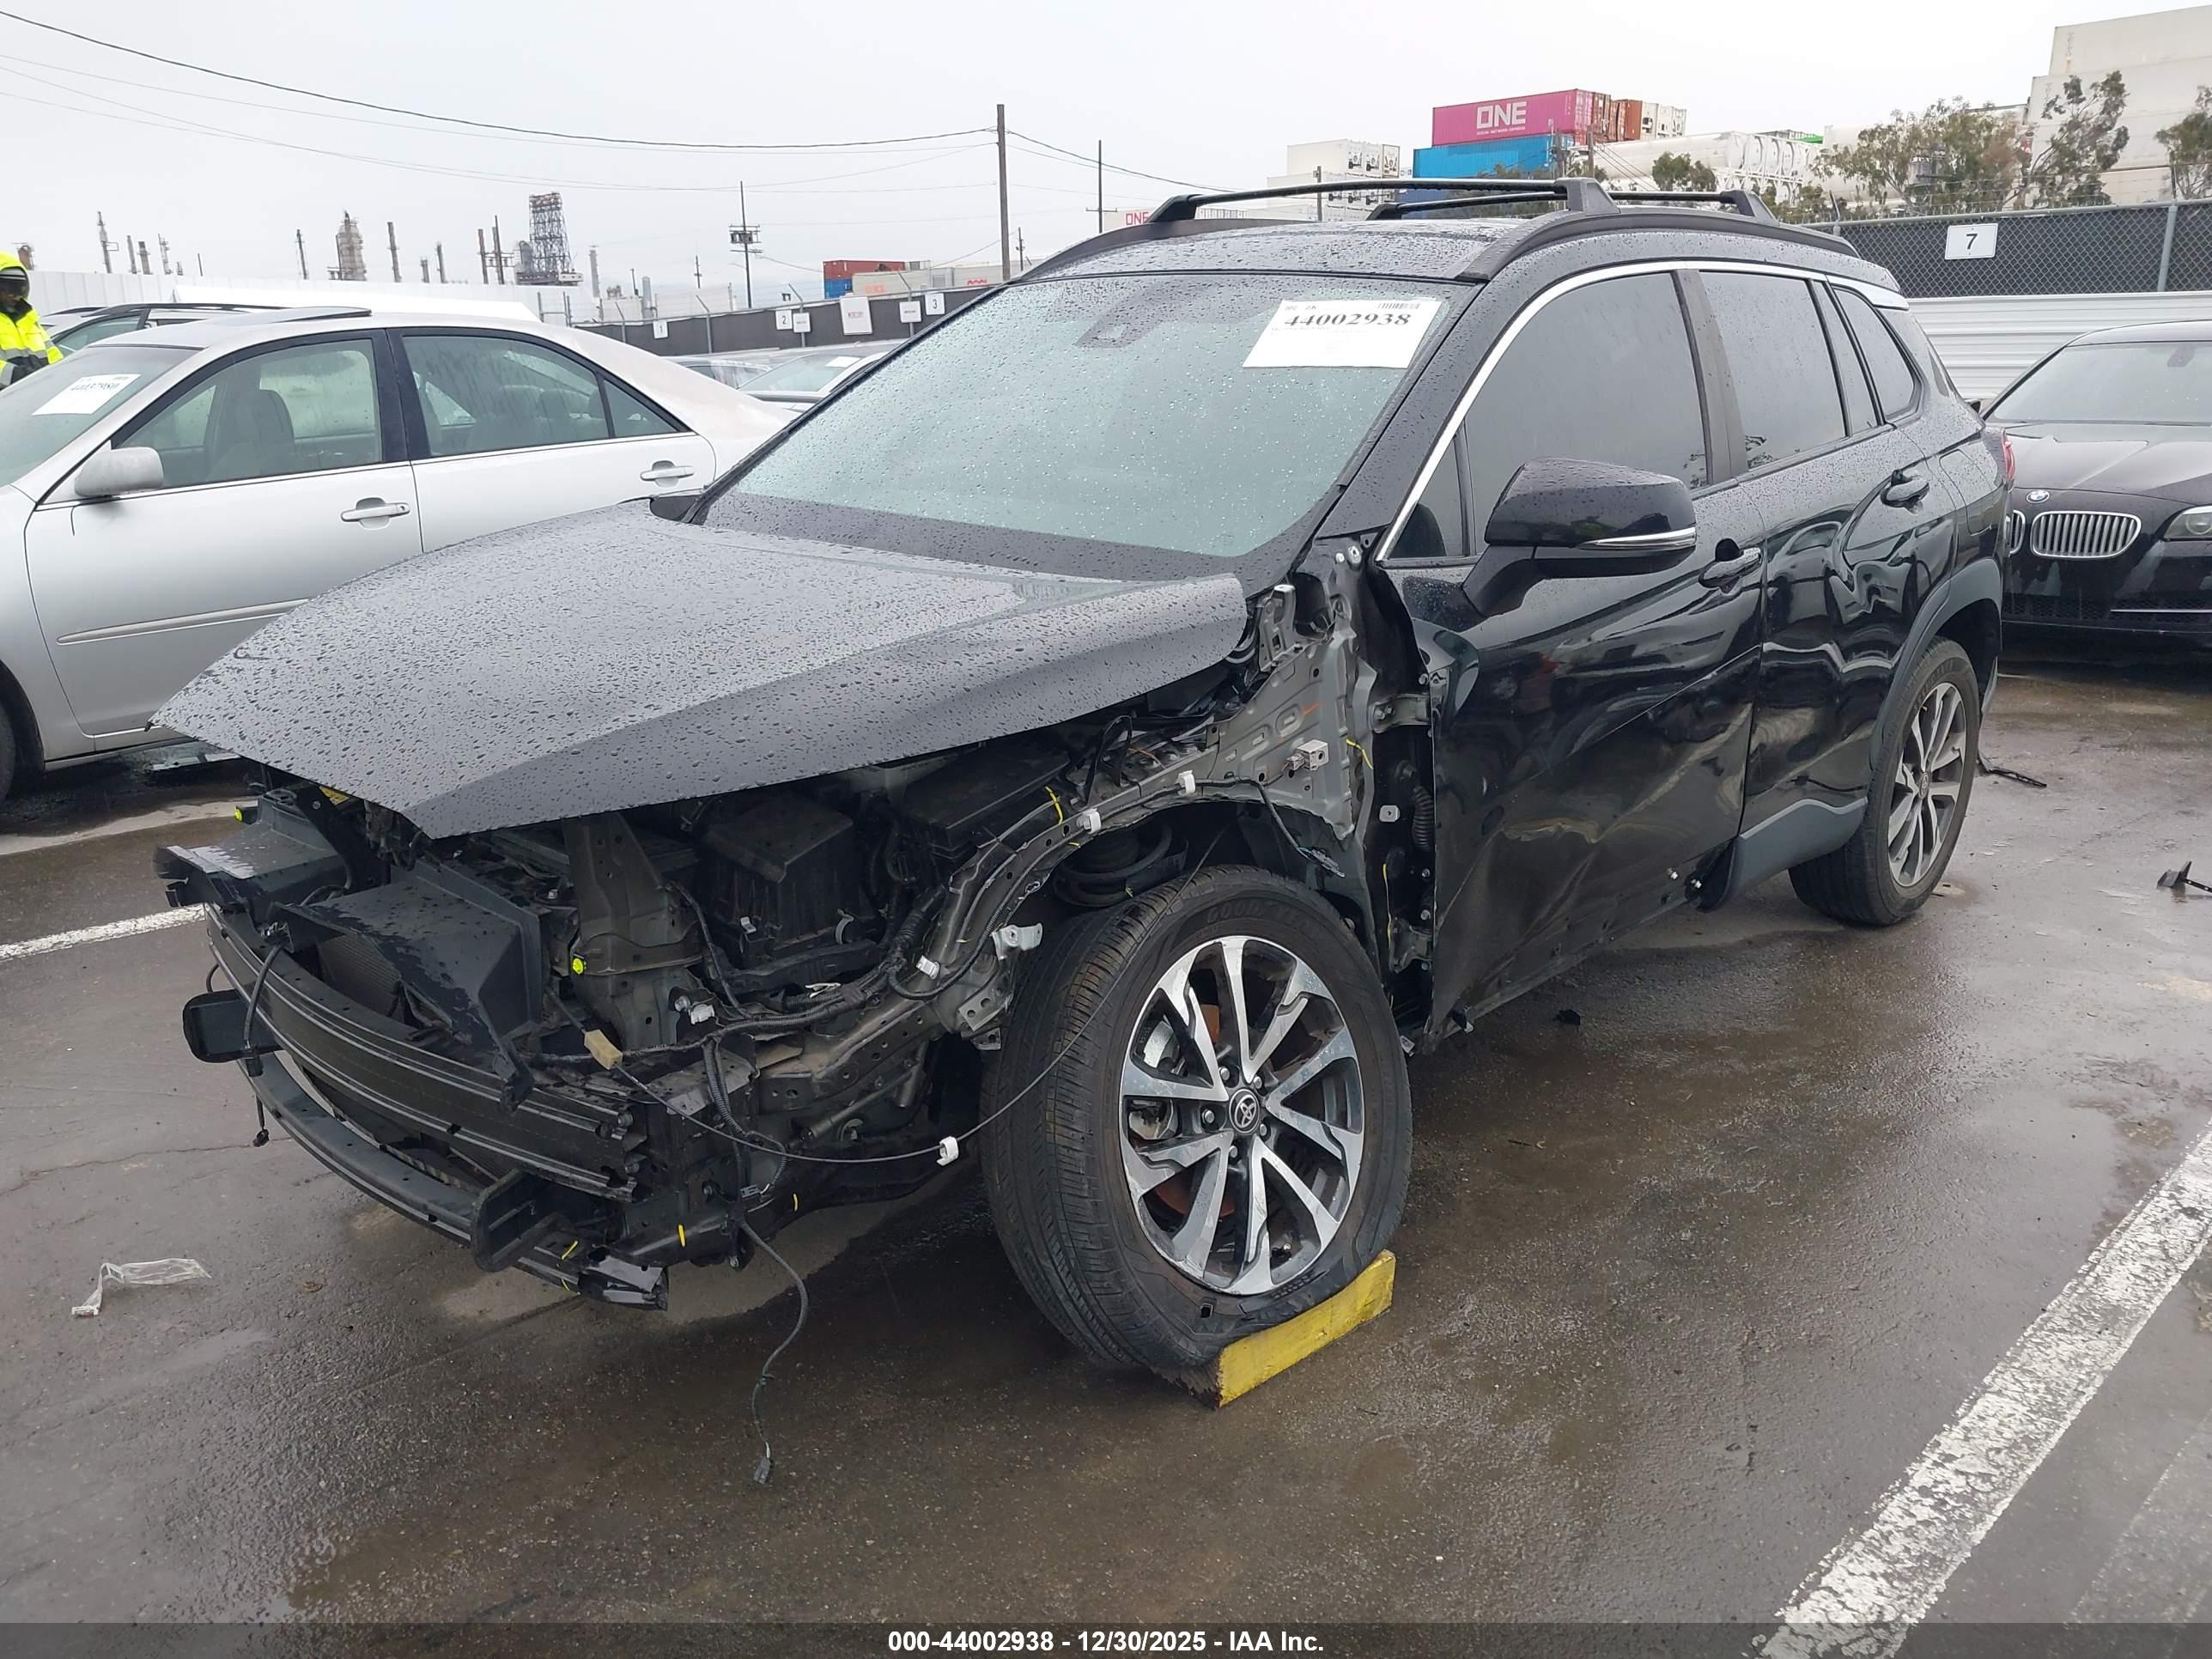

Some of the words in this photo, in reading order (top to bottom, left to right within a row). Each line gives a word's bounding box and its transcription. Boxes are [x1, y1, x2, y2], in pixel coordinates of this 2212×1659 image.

[1477, 101, 1527, 129] ONE
[1966, 234, 1978, 250] 7
[933, 299, 938, 310] 3
[782, 315, 787, 325] 2
[1284, 313, 1412, 326] 44002938
